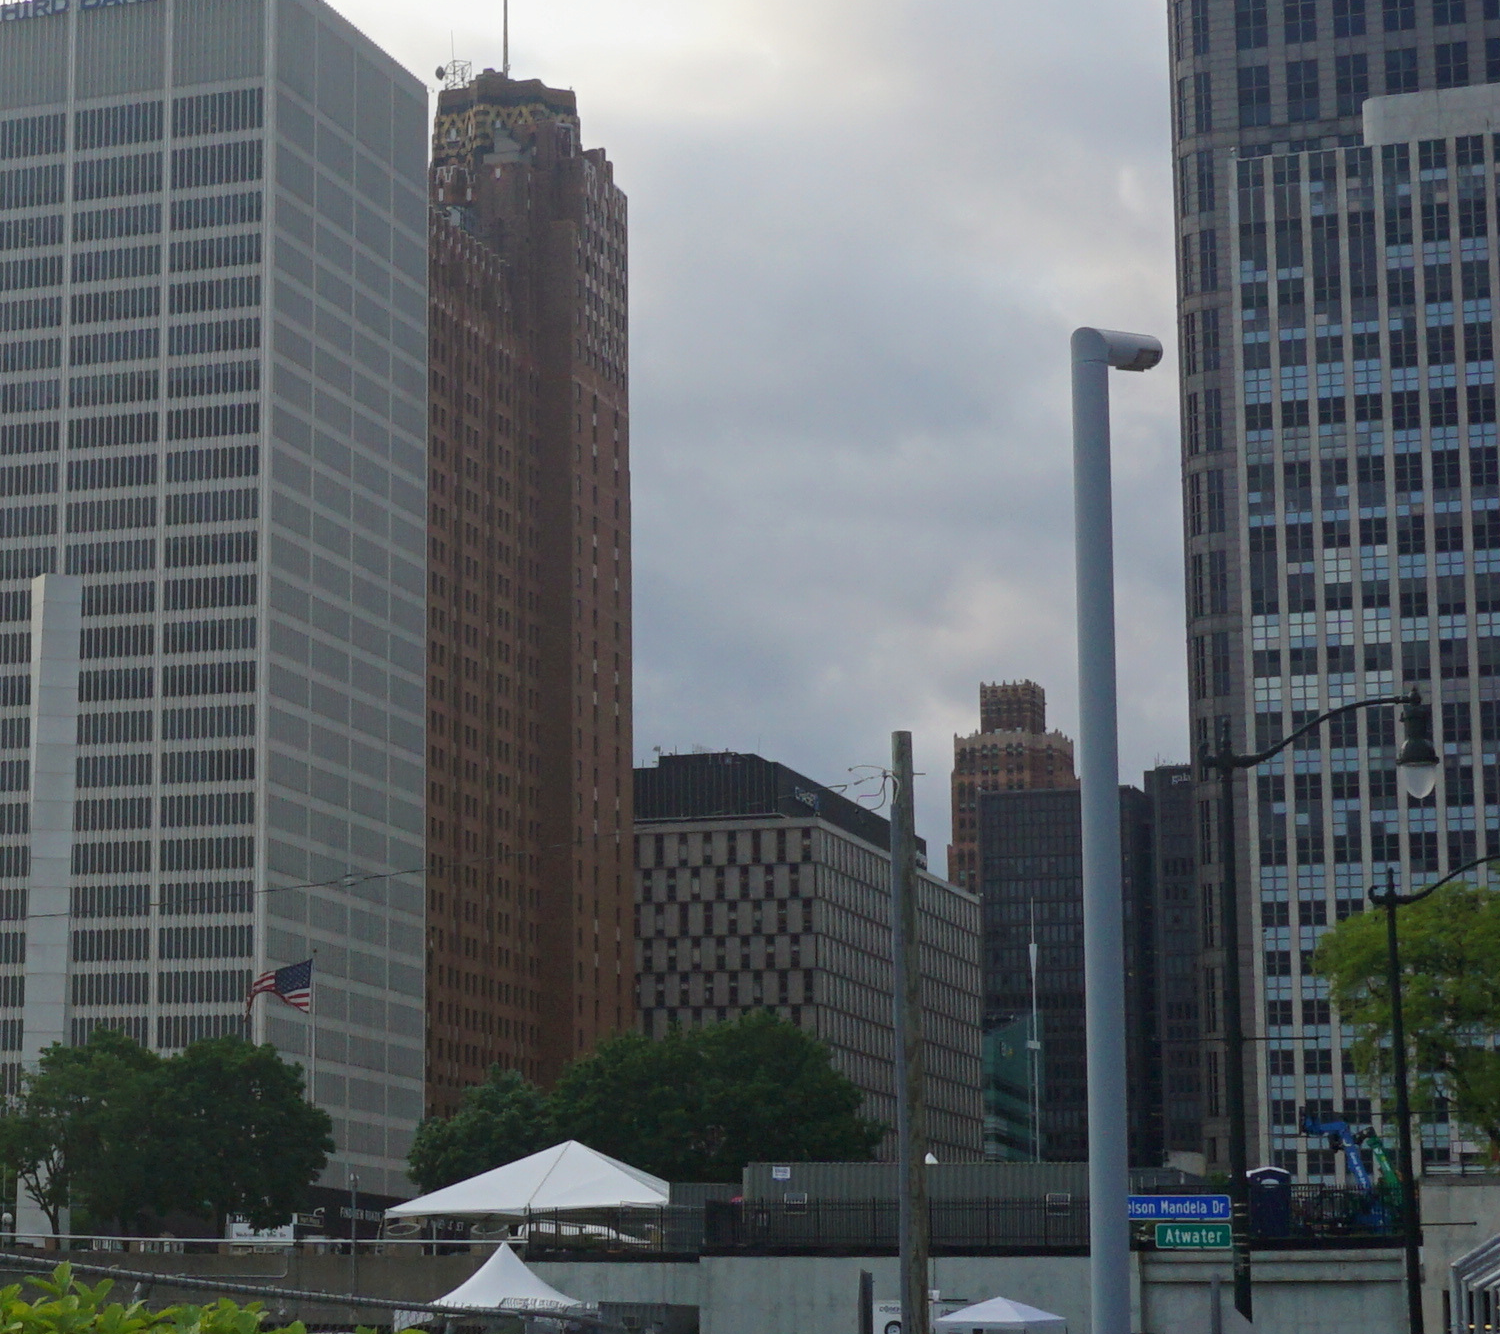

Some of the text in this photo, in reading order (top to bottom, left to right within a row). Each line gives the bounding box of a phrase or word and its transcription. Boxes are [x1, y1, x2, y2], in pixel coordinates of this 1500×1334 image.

[1128, 1200, 1225, 1214] elson Mandela Dr
[1165, 1228, 1222, 1244] Atwater
